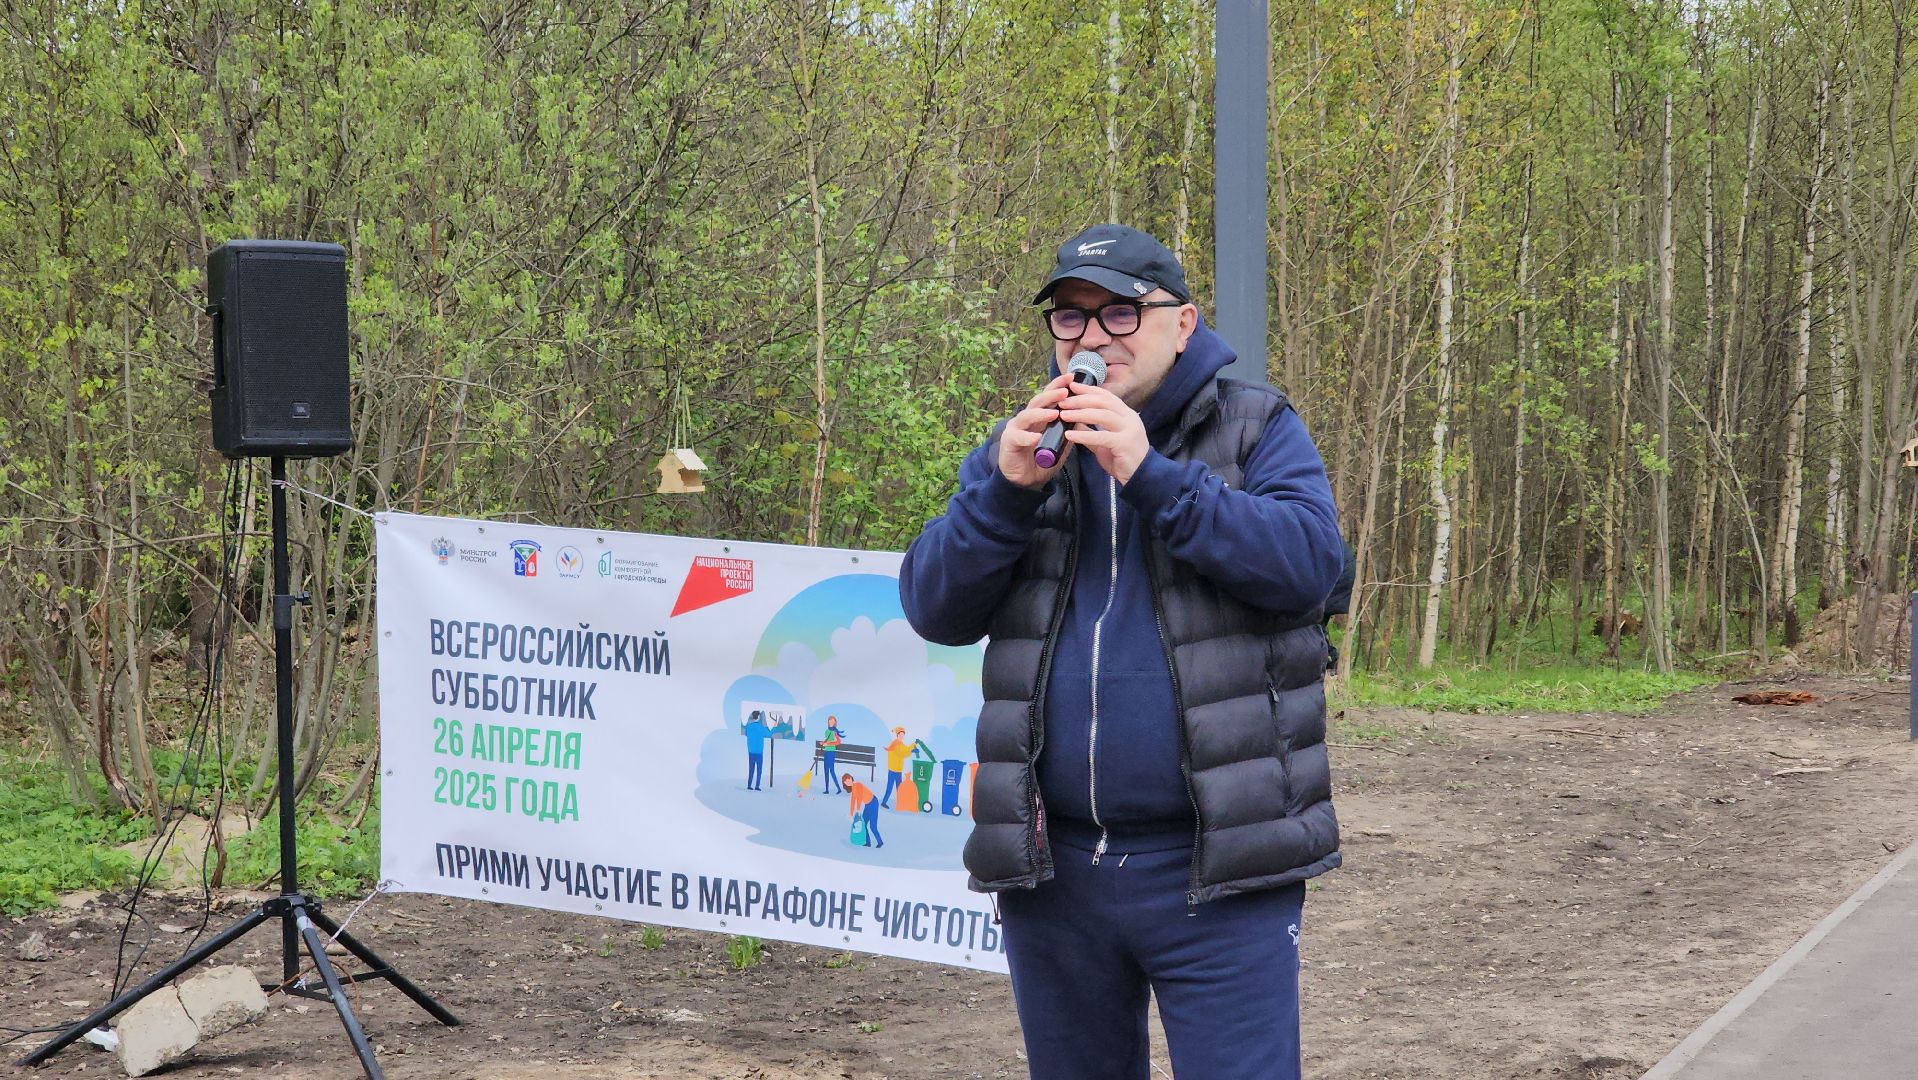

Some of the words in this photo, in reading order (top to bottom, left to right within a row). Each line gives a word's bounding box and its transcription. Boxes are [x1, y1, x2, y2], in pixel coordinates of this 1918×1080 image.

[460, 548, 497, 558] МИНСТРОЙ
[460, 555, 487, 564] РОССИИ
[696, 557, 753, 570] НАЦИОНАЛЬНЫЕ
[614, 574, 647, 582] ГОРОДСКОЙ
[647, 576, 667, 584] СРЕДЫ
[720, 568, 753, 581] ПРОЕКТЫ
[725, 578, 753, 590] РОССИИ
[430, 619, 672, 676] ВСЕРОССИЙСКИЙ
[431, 668, 598, 721] СУББОТНИК
[433, 717, 464, 757] 26
[471, 723, 582, 770] АПРЕЛЯ
[434, 766, 497, 811] 2025
[505, 777, 580, 824] ГОДА
[435, 842, 530, 890] ПРИМИ
[536, 857, 662, 907] УЧАСТИЕ
[671, 872, 690, 911] В
[698, 875, 866, 933] МАРАФОНЕ
